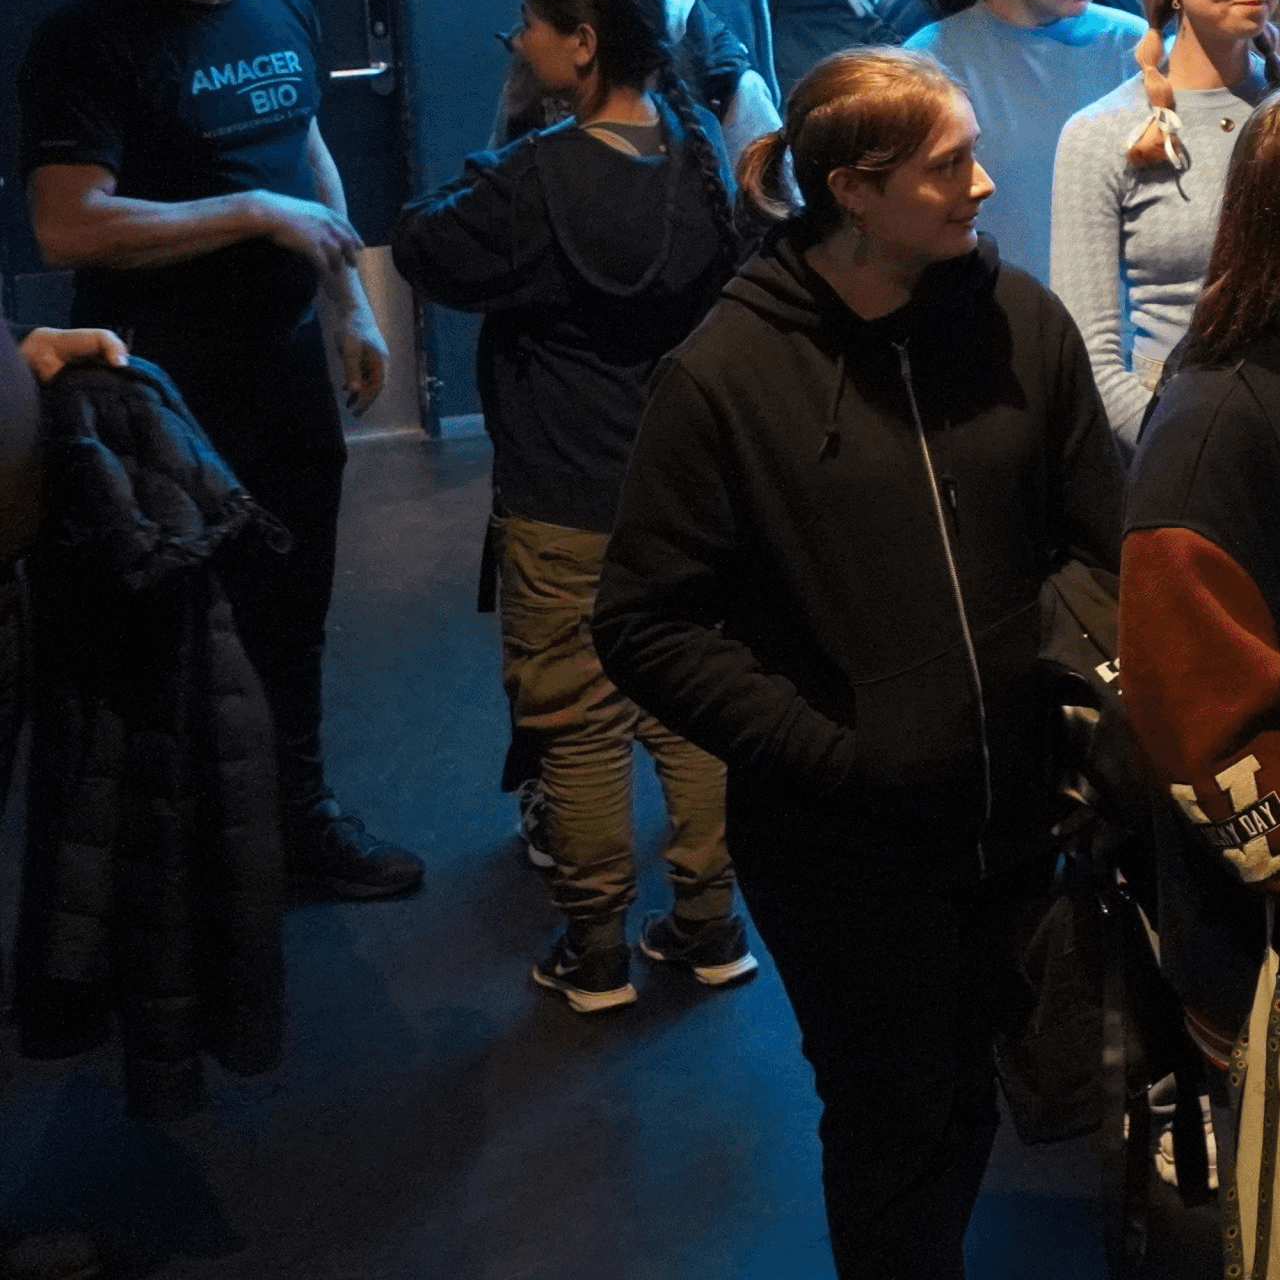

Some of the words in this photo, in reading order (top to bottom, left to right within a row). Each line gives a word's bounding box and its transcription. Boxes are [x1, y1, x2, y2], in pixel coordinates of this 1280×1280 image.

[192, 51, 302, 95] AMAGER
[251, 84, 297, 114] BIO
[1239, 801, 1276, 837] DAY
